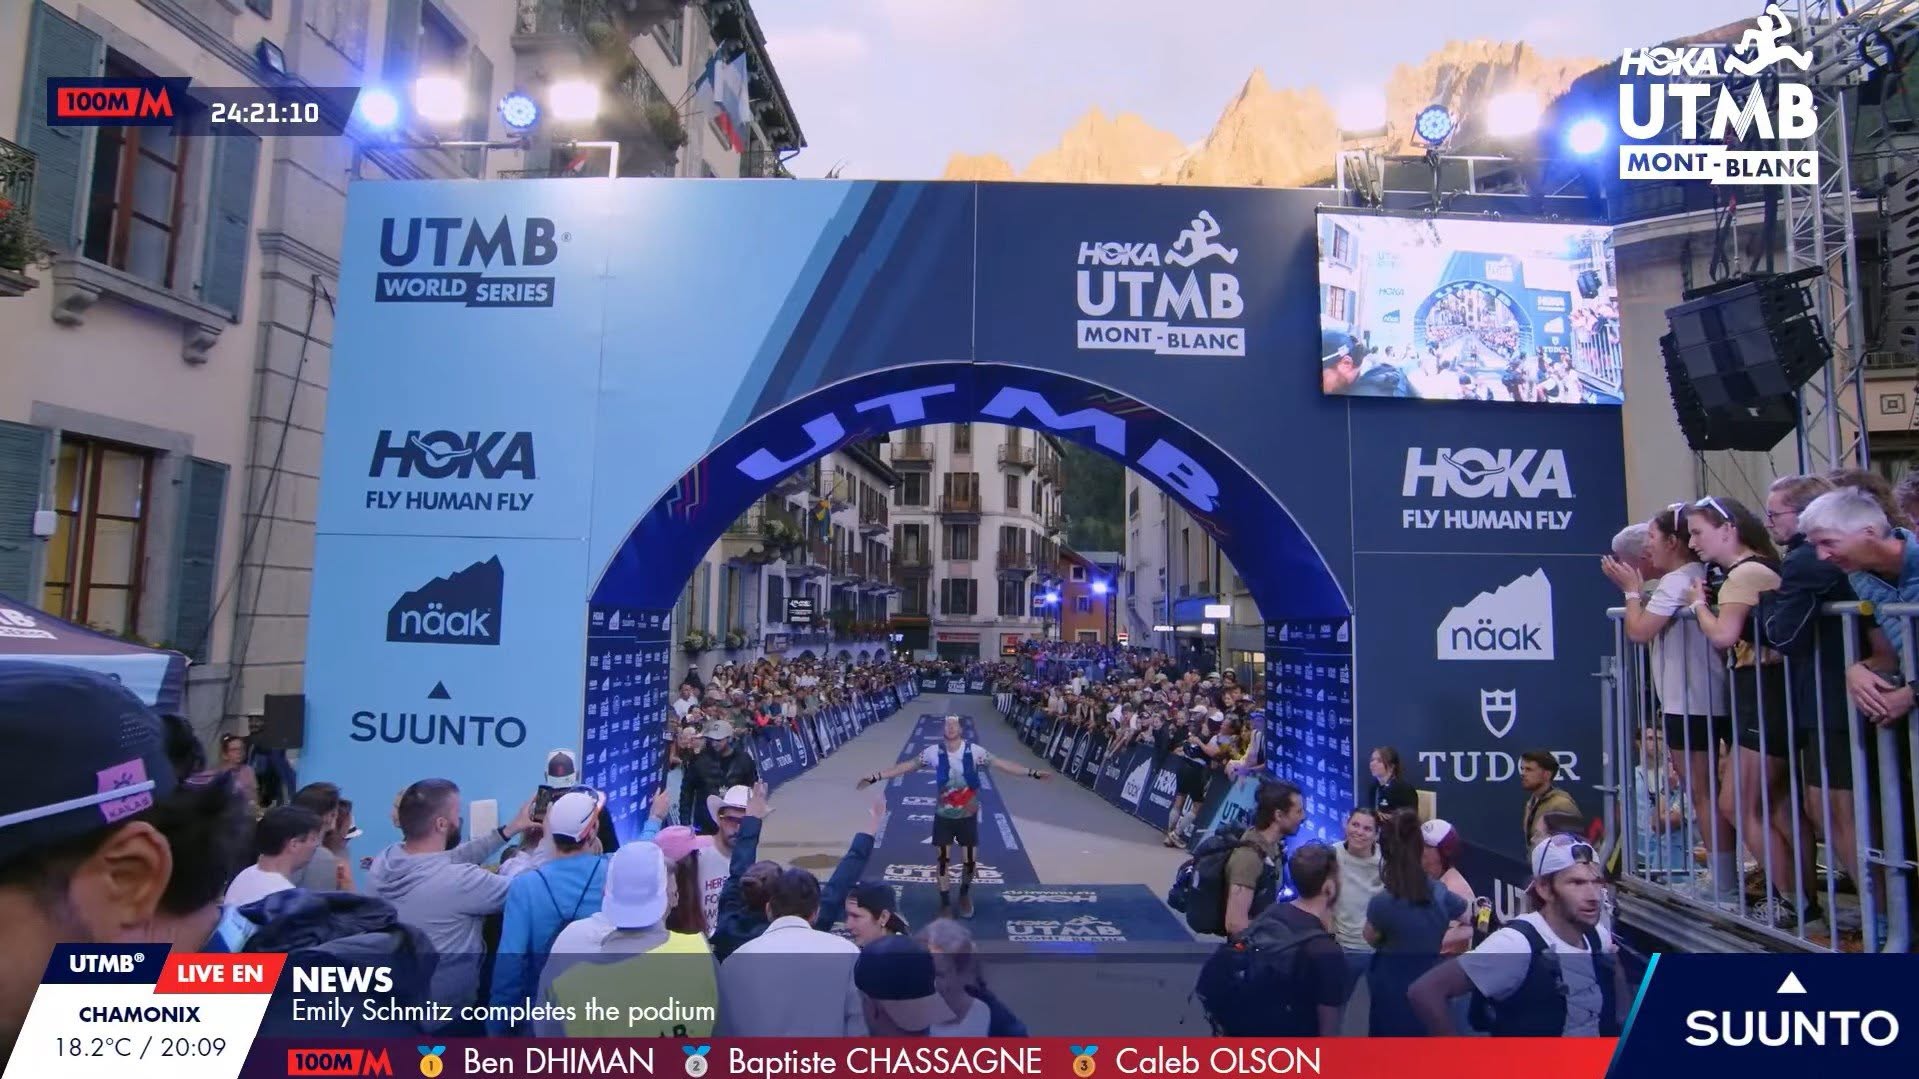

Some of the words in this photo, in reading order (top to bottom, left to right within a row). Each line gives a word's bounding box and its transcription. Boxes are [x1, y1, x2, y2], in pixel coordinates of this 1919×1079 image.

[1077, 241, 1161, 267] HOKA
[384, 278, 467, 297] WORLD
[475, 283, 548, 302] SERIES
[1077, 269, 1244, 320] UTMB
[368, 429, 537, 480] HOKA
[735, 383, 1220, 513] UTMB
[1402, 446, 1573, 499] HOKA
[366, 491, 403, 510] FLY
[406, 491, 492, 511] HUMAN
[497, 492, 534, 512] FLY
[1402, 509, 1440, 529] FLY
[1444, 510, 1532, 530] HUMAN
[1536, 510, 1573, 531] FLY
[400, 603, 491, 637] näak
[1452, 618, 1542, 651] näak
[350, 710, 527, 748] SUUNTO
[1419, 751, 1581, 783] TUDR
[1007, 925, 1122, 936] UTMB
